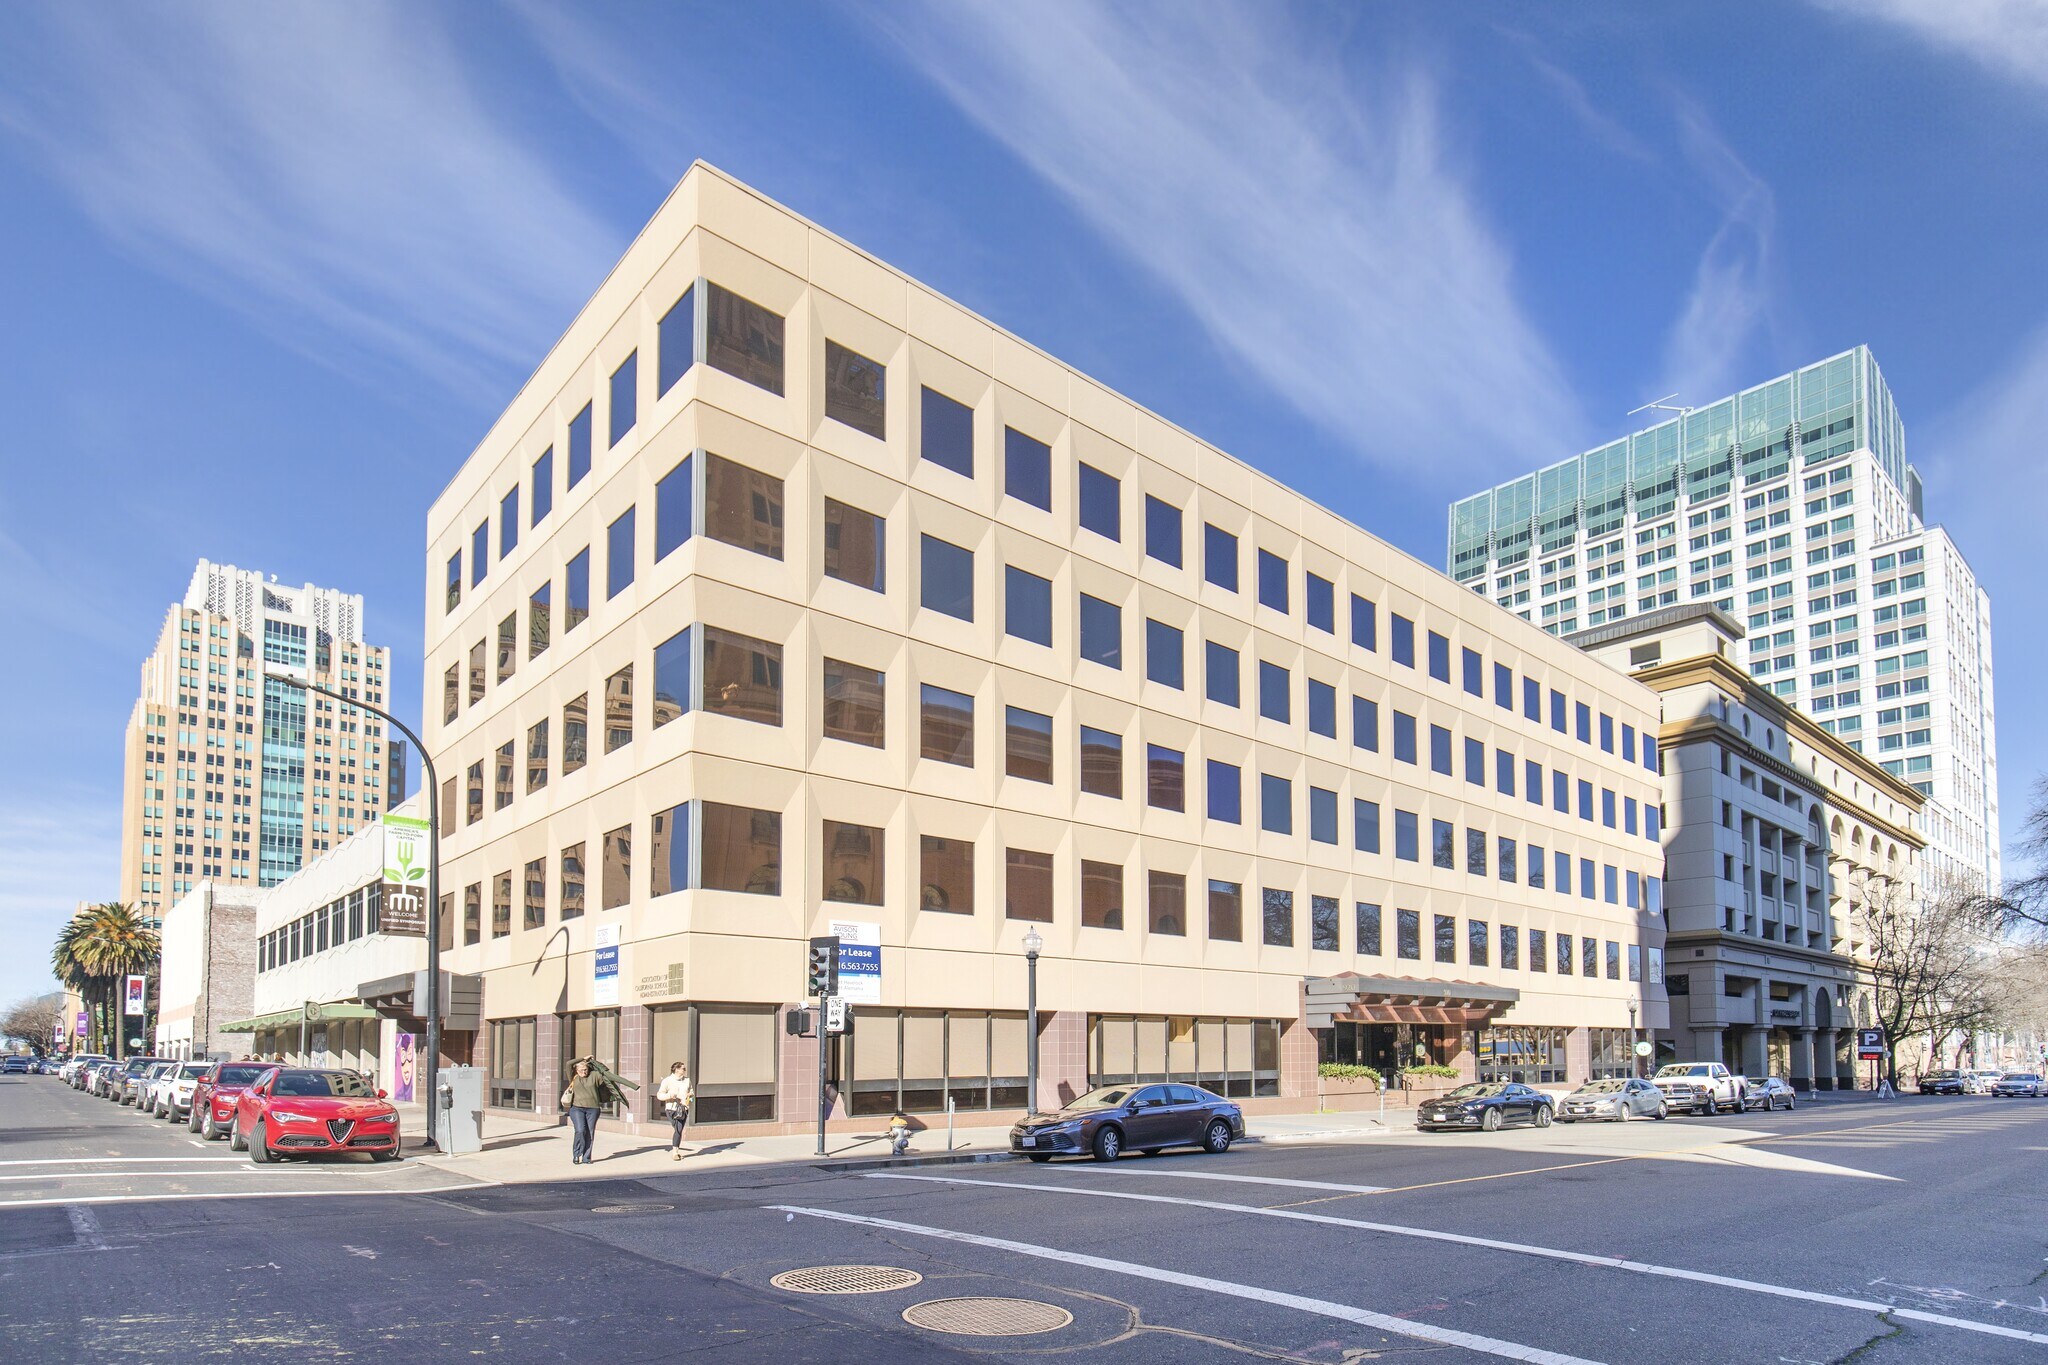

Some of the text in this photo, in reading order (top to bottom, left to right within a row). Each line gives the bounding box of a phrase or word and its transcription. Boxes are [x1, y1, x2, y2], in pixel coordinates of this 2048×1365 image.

[603, 951, 615, 960] Lease
[848, 948, 872, 958] Lease
[838, 961, 879, 971] 16.563.7555
[831, 999, 842, 1008] ONE
[831, 1009, 841, 1017] WAY
[1864, 1033, 1878, 1045] P
